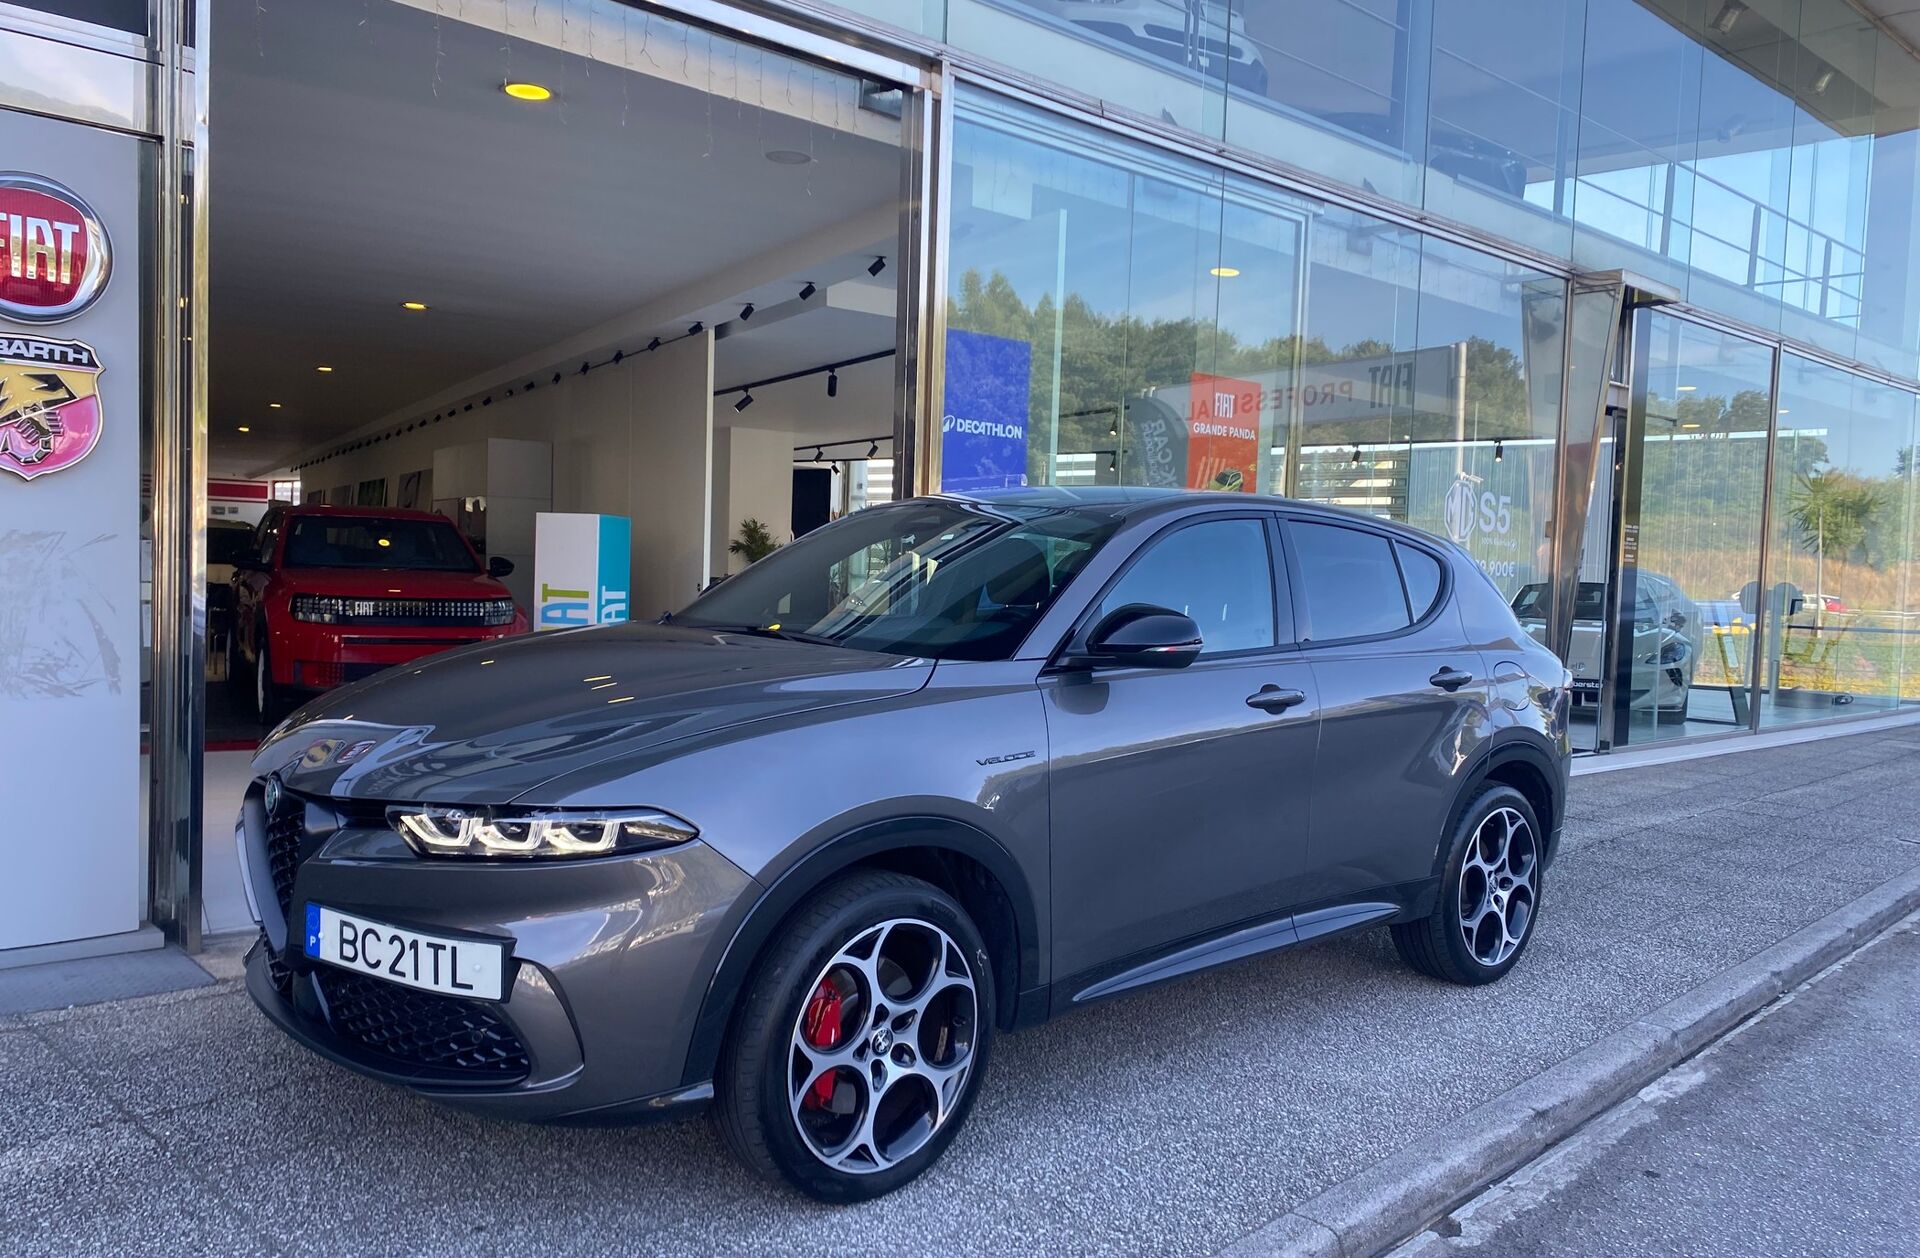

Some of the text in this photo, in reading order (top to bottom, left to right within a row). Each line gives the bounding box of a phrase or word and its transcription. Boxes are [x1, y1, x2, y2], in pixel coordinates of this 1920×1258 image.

[1214, 392, 1235, 418] FIAT
[957, 418, 1022, 439] DECATHLON
[1193, 422, 1256, 440] GRANDE PANDA
[1446, 484, 1511, 538] MG S5
[355, 601, 375, 616] FIAT
[976, 750, 1036, 766] VELOCE
[309, 935, 316, 947] P
